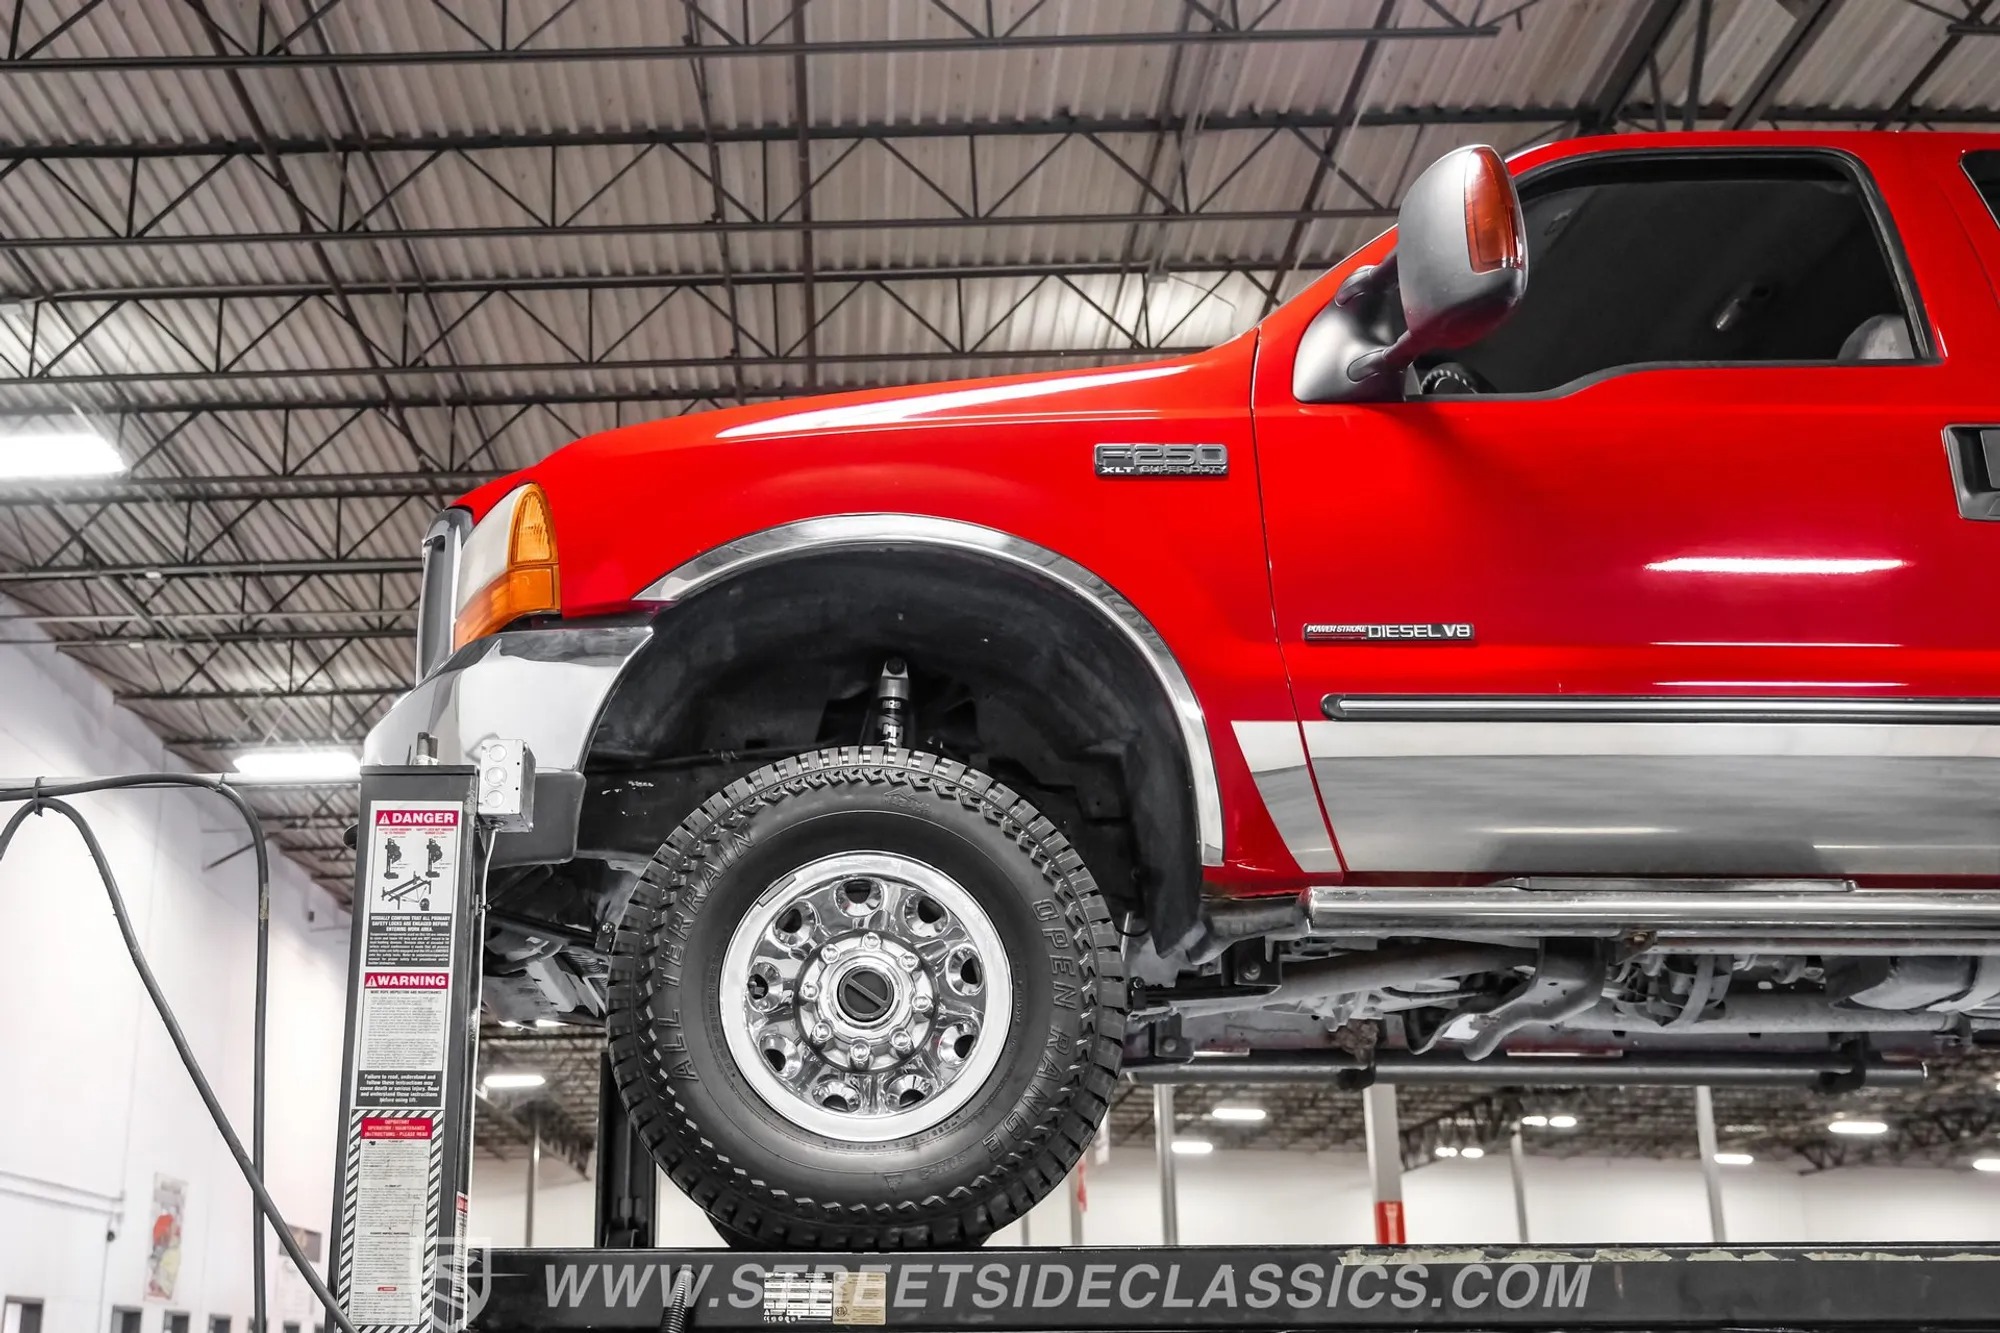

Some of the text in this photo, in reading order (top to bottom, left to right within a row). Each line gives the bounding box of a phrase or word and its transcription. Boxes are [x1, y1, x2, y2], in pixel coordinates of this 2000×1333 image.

[1139, 465, 1186, 474] SUPER
[1189, 465, 1227, 474] DUTY
[1307, 624, 1471, 638] POWER STROKE DIESEL V8
[392, 812, 454, 824] DANGER
[377, 975, 446, 986] WARNING
[981, 899, 1078, 1163] OPEN RANGE
[657, 1009, 700, 1082] ALL
